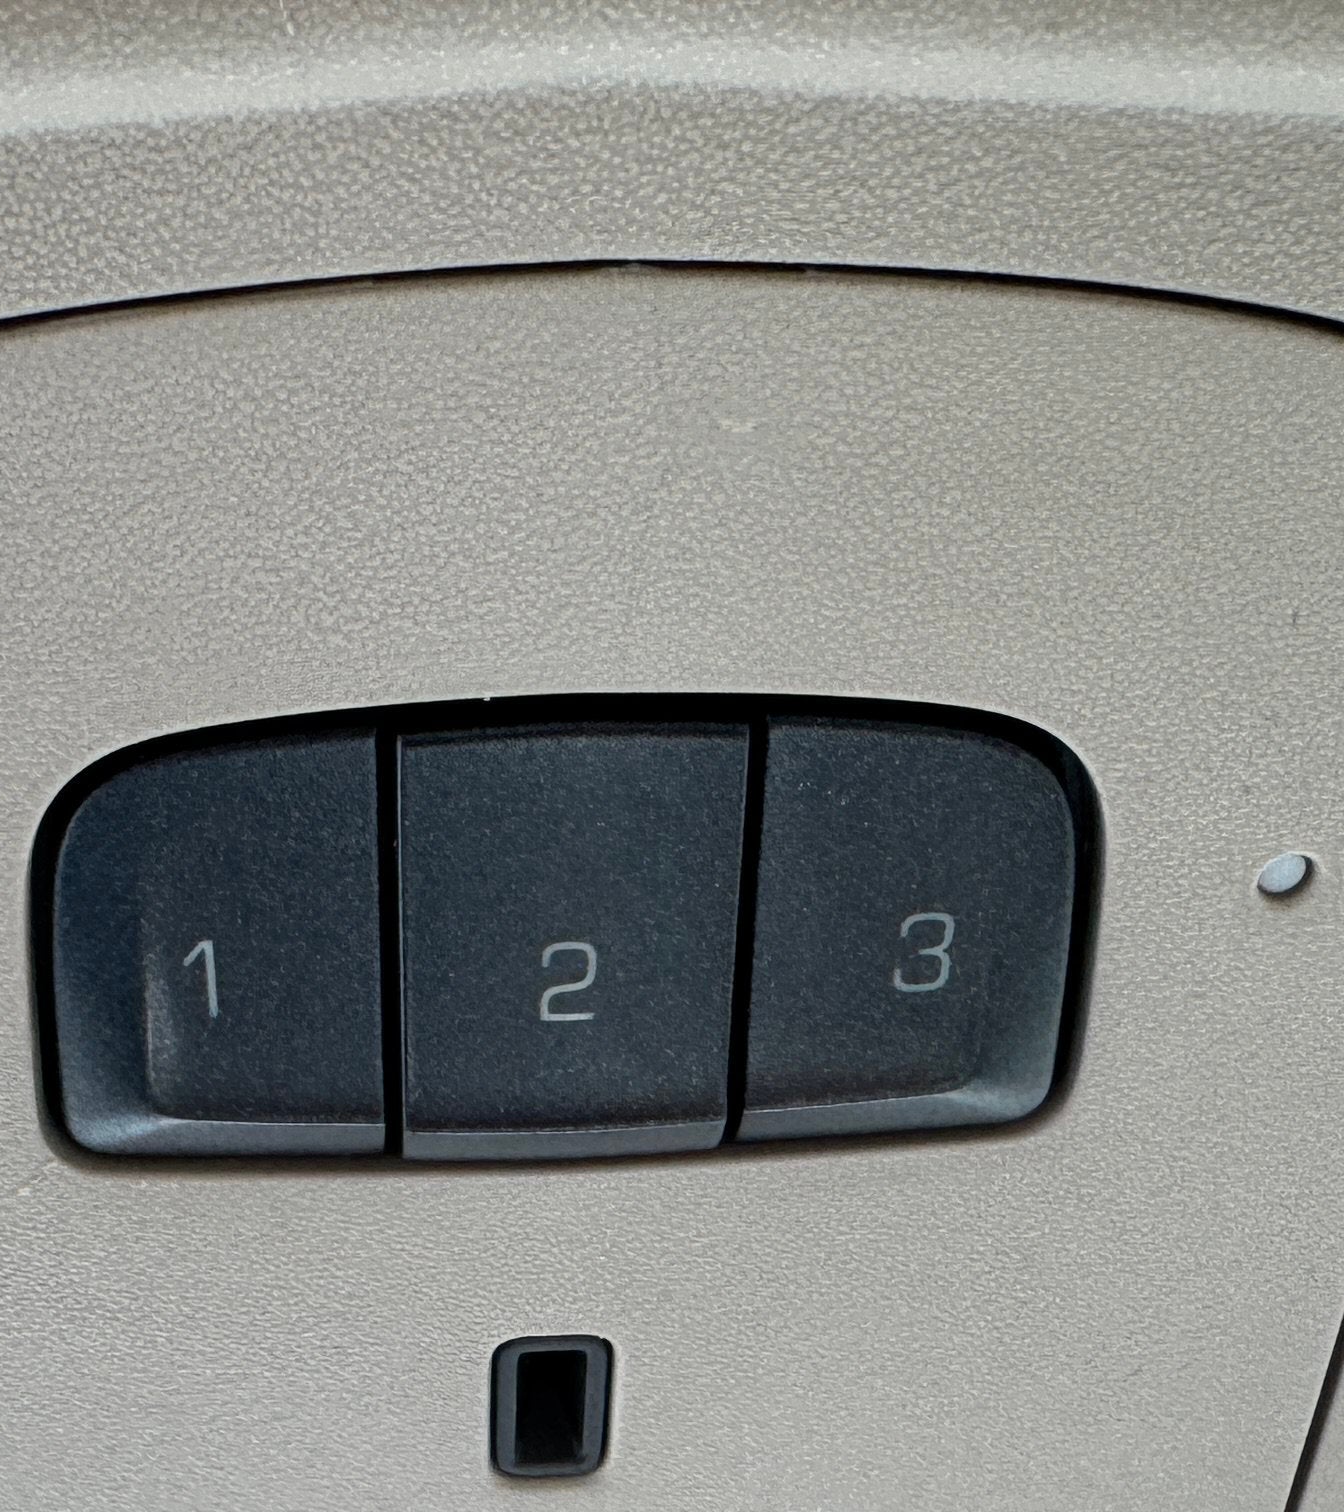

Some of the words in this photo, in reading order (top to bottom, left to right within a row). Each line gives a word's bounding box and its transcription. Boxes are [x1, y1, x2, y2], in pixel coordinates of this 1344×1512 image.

[182, 939, 219, 1019] 1
[539, 941, 598, 1022] 2
[893, 912, 954, 992] 3
